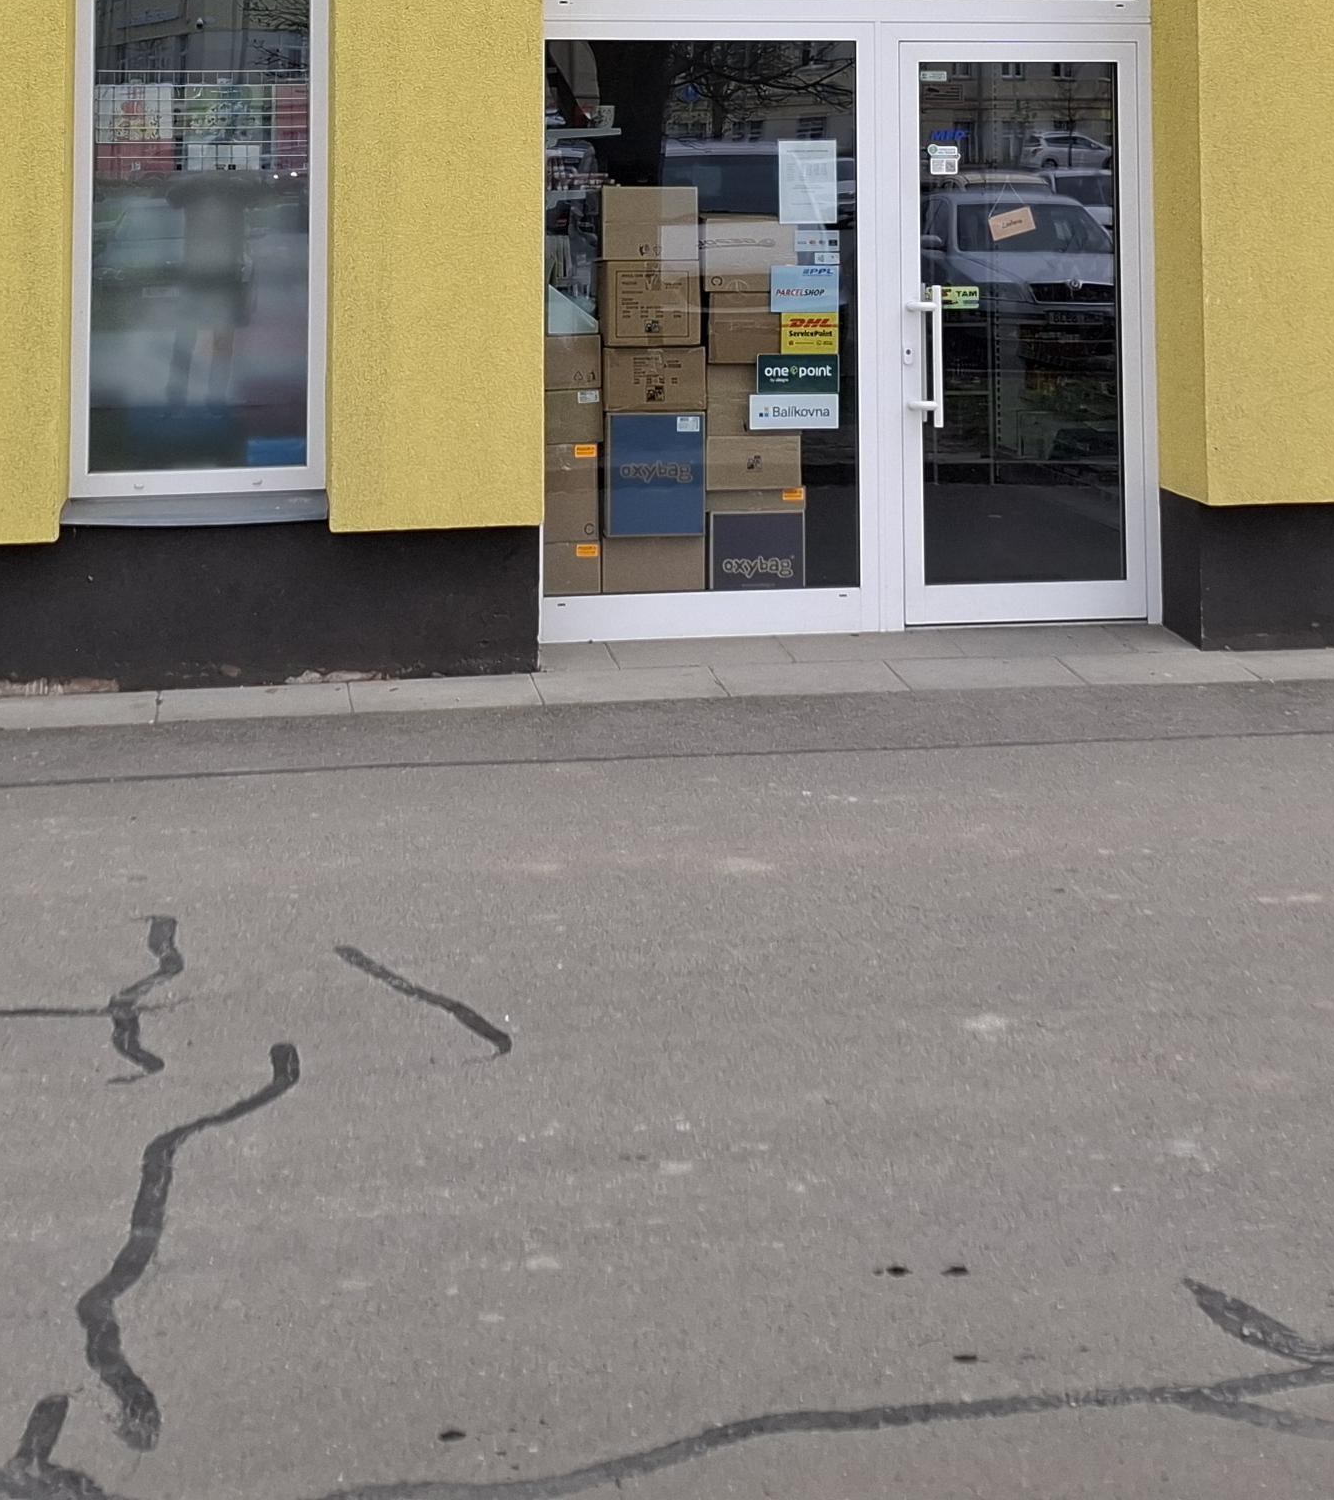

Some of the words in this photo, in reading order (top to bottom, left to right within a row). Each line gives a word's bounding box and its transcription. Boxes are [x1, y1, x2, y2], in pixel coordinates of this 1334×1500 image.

[775, 288, 825, 297] PARCELSHOP
[788, 318, 833, 328] DHL
[788, 330, 833, 338] ServicePoint
[764, 366, 789, 377] one
[798, 364, 832, 379] point
[772, 406, 830, 418] Balíkovna
[619, 460, 694, 483] oxybag
[722, 556, 794, 579] oxybag
